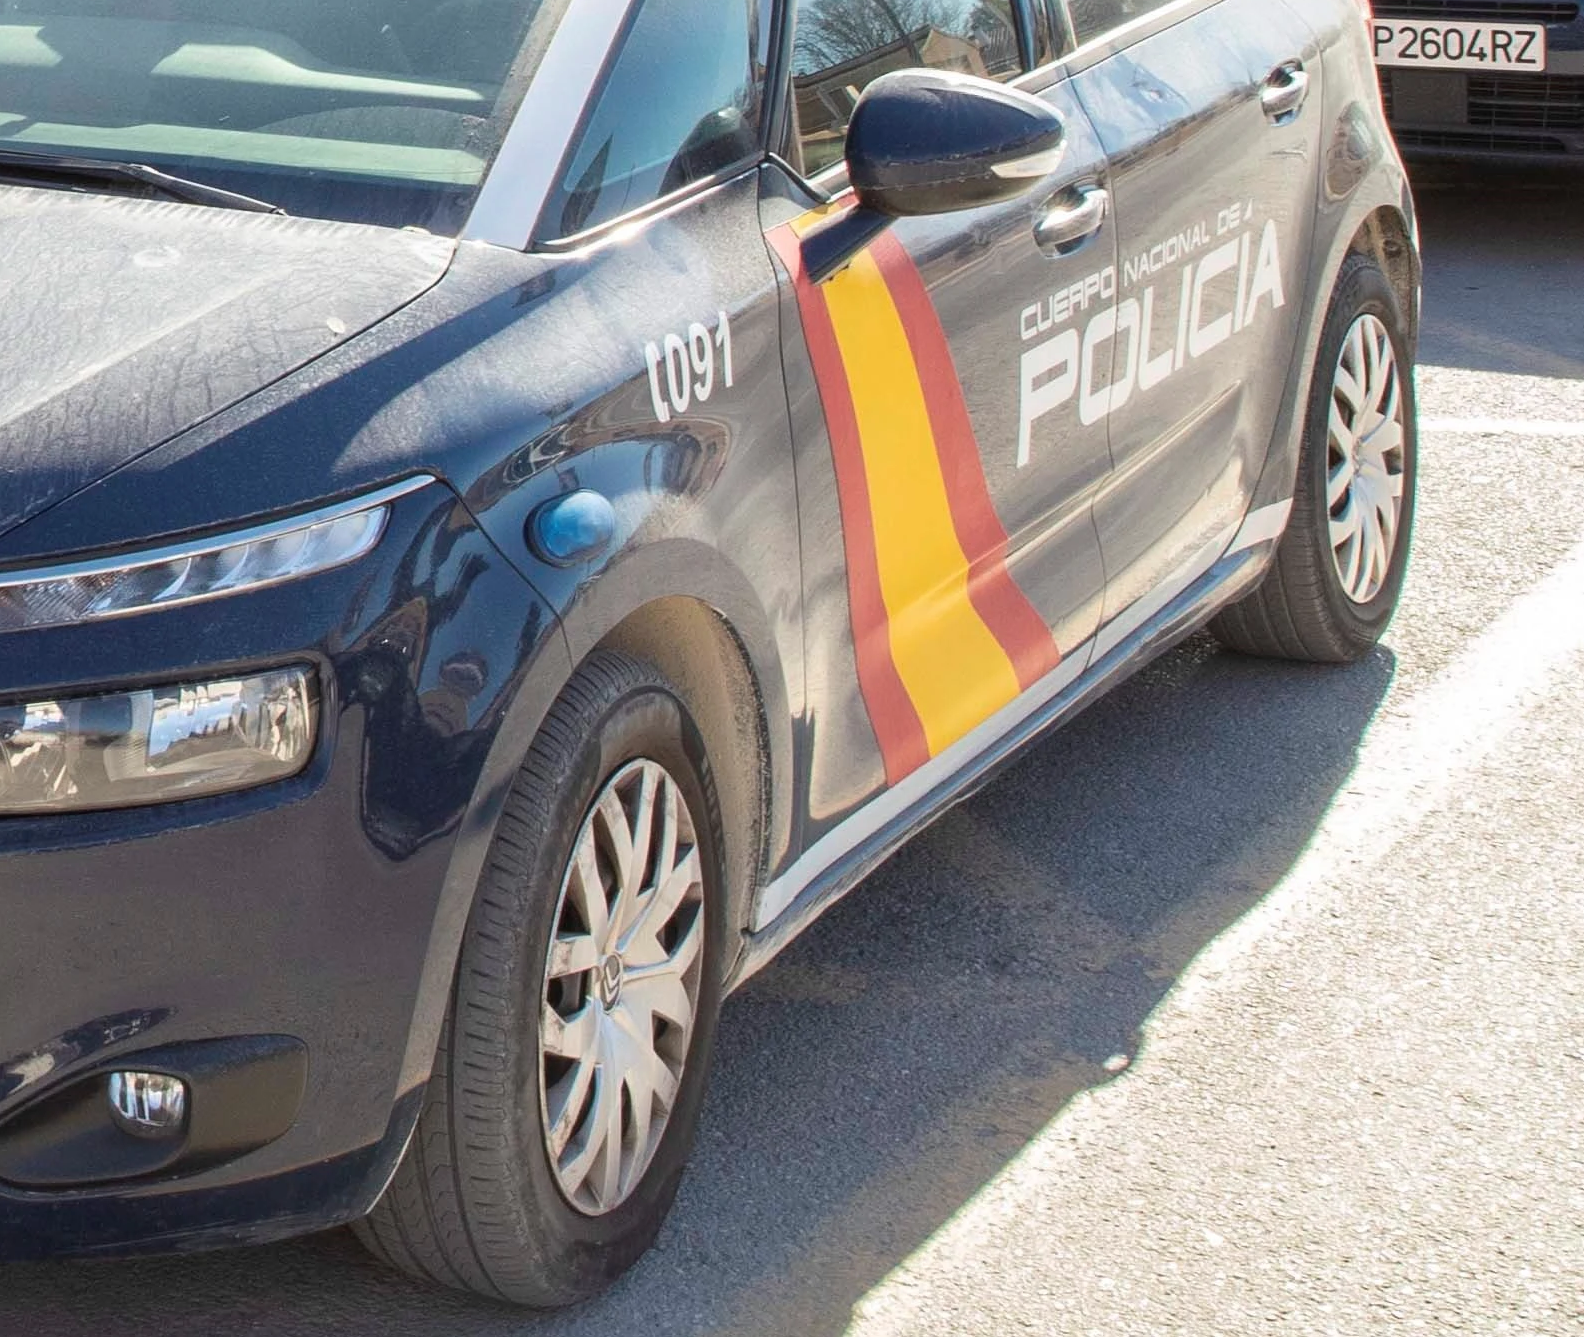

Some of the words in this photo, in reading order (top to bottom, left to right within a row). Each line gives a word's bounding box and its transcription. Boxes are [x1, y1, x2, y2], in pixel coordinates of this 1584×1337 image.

[1020, 265, 1115, 340] CUERPO
[1124, 221, 1211, 287] NACIONAL
[1216, 202, 1241, 236] DE
